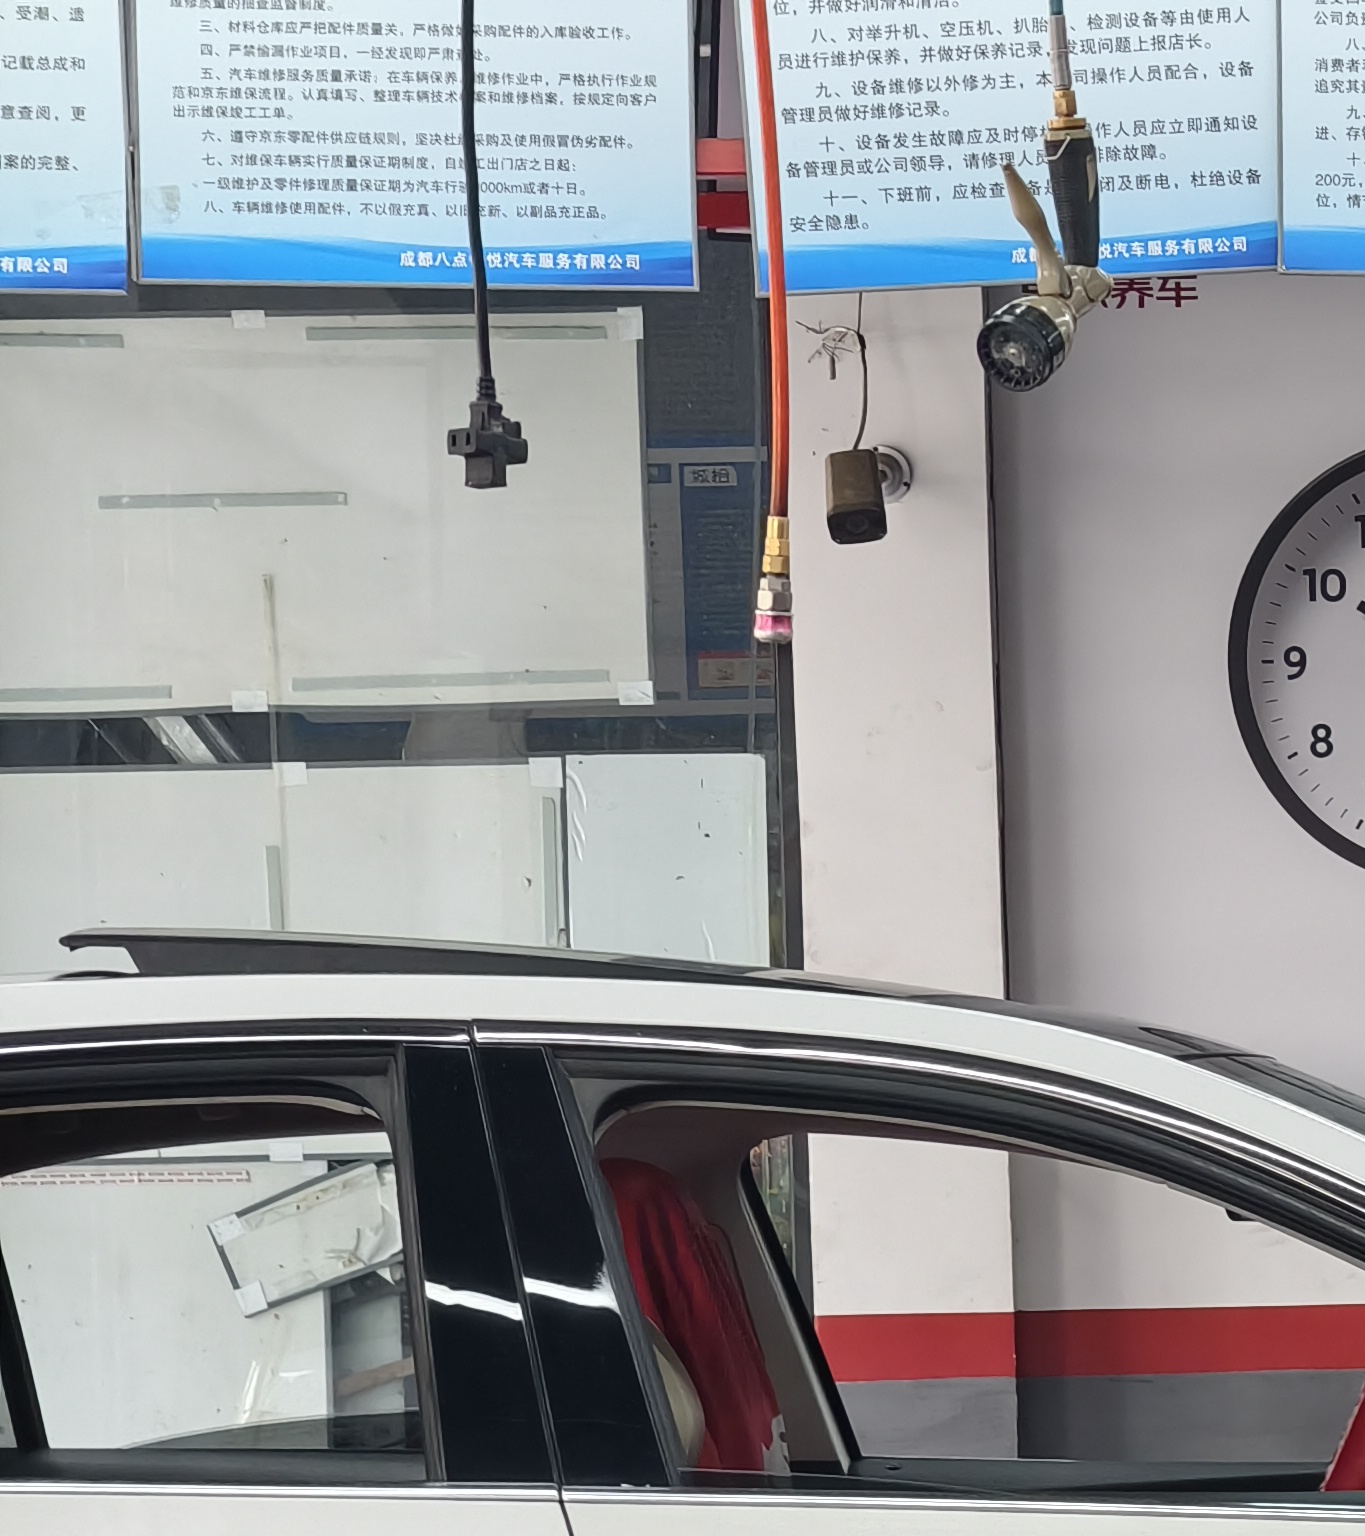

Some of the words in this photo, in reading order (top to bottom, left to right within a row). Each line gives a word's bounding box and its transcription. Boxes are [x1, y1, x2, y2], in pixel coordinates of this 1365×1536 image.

[811, 5, 1251, 43] 八、对举升机、空压机、扒胎、检测设备等由使用人
[816, 60, 1255, 98] 九、设备维修以外修为主，本司操作人员配合，设备
[781, 98, 951, 125] 管理员做好维修记录。
[819, 114, 1258, 152] 十、设备发生故障应及时停作人员应立即通知设
[0, 154, 80, 172] 案的完整、
[789, 213, 870, 233] 安全隐患。
[0, 257, 69, 274] 有限公司
[1302, 568, 1347, 602] 10
[1283, 645, 1307, 680] 9
[1310, 723, 1334, 758] 8
